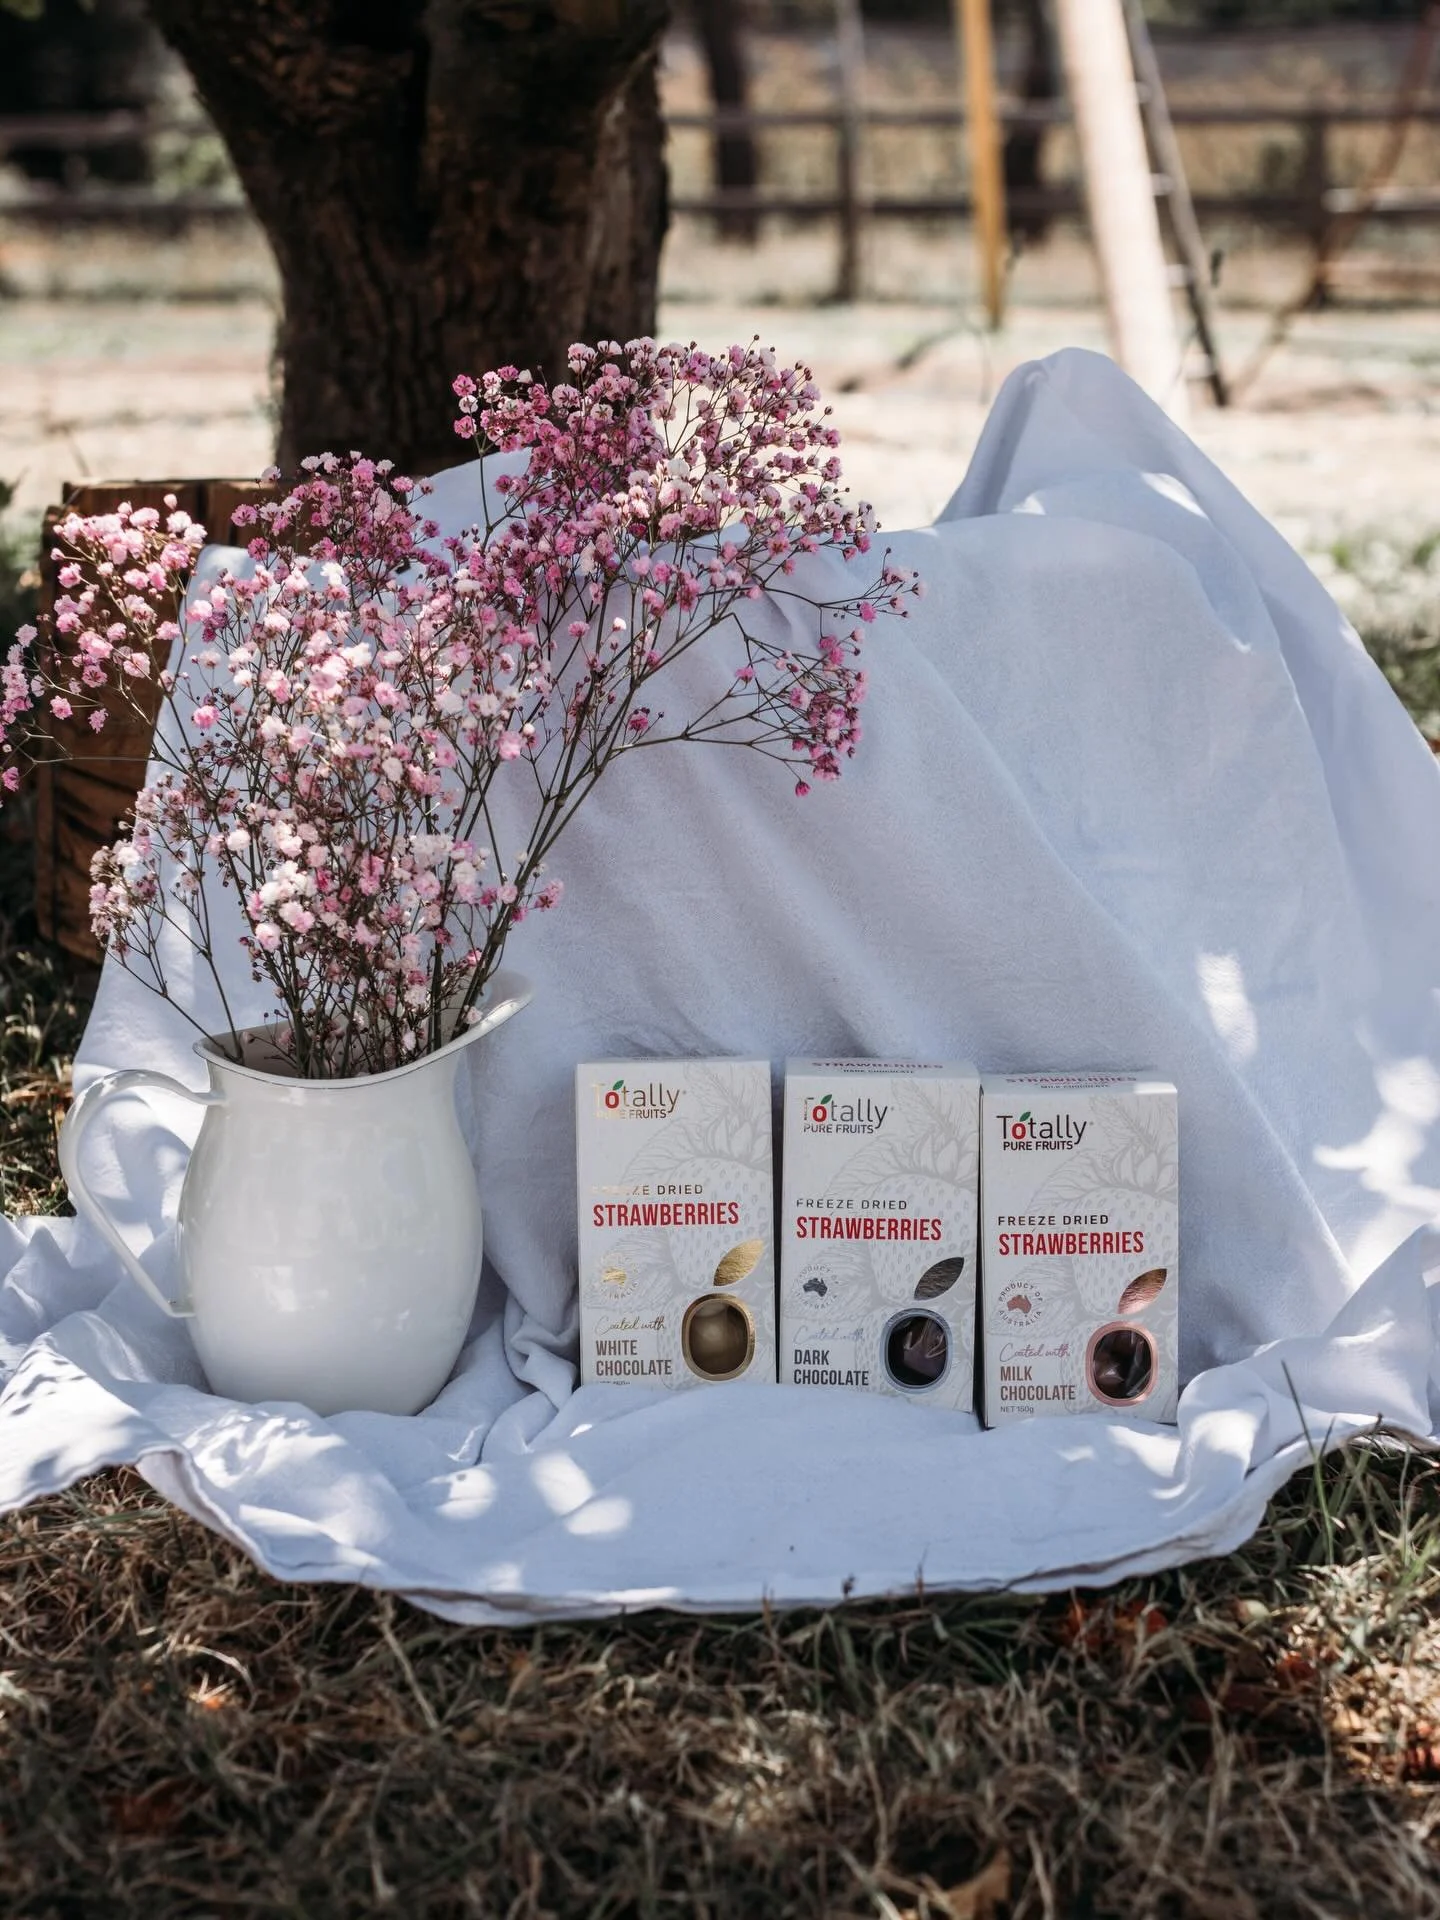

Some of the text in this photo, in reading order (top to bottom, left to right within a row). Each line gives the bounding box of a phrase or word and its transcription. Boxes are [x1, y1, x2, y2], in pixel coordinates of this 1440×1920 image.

[591, 1083, 680, 1113] Totally
[629, 1109, 667, 1119] FRUITS
[799, 1098, 888, 1129] Totally
[803, 1124, 874, 1134] PURE FRUITS
[996, 1114, 1087, 1144] Totally
[1003, 1140, 1073, 1151] PURE FRUITS
[657, 1184, 703, 1195] DRIED
[796, 1199, 907, 1210] FREEZE DRIED
[593, 1201, 739, 1227] STRAWBERRIES
[998, 1214, 1109, 1226] FREEZE DRIED
[796, 1216, 942, 1241] STRAWBERRIES
[998, 1231, 1144, 1256] STRAWBERRIES
[998, 1281, 1034, 1302] PRODUCT
[998, 1310, 1042, 1327] AUSTRALIA
[596, 1339, 638, 1356] WHITE
[999, 1342, 1071, 1363] Coated with
[794, 1349, 830, 1365] DARK
[596, 1359, 673, 1376] CHOCOLATE
[1000, 1365, 1033, 1381] MILK
[793, 1369, 869, 1386] CHOCOLATE
[1000, 1385, 1076, 1401] CHOCOLATE
[1000, 1405, 1016, 1413] NET
